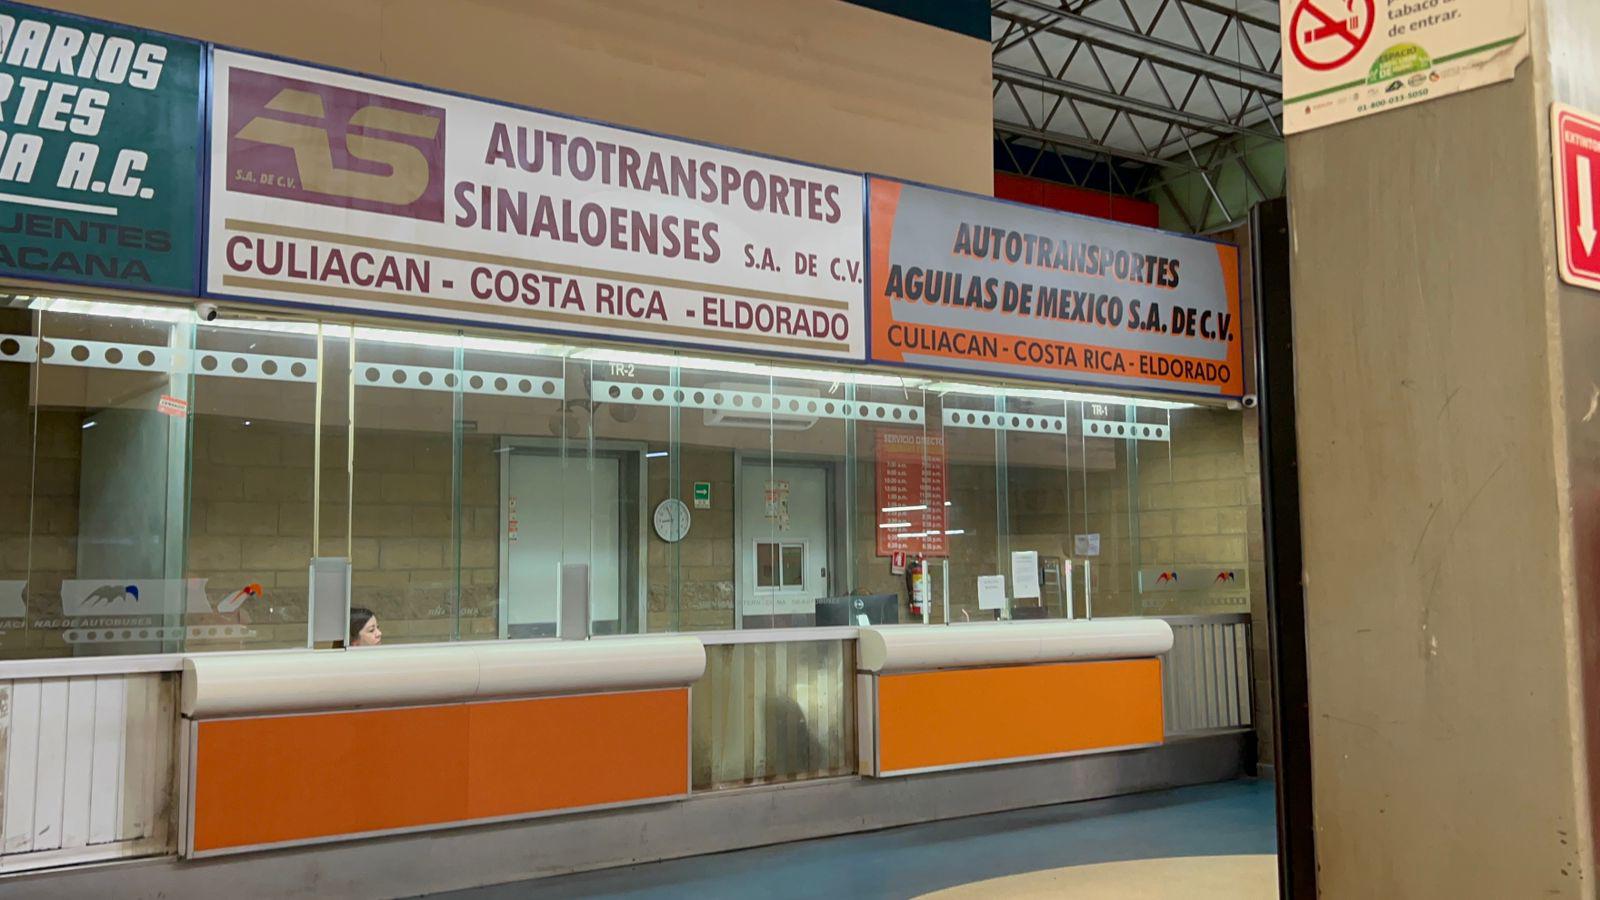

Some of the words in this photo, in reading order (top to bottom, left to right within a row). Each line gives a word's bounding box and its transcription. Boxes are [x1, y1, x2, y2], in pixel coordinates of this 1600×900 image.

[1387, 0, 1439, 20] tabaco
[1388, 24, 1406, 38] de
[1409, 9, 1462, 31] entrar.
[56, 141, 155, 199] A.C.
[235, 169, 256, 183] S.A.
[260, 173, 274, 185] DE
[277, 176, 296, 189] C.V.
[485, 121, 842, 224] AUTOTRANSPORTES
[454, 181, 721, 264] SINALOENSES
[744, 243, 781, 273] S.A.
[795, 252, 818, 278] DE
[830, 257, 863, 284] C.V.
[953, 222, 1180, 289] AUTOTRANSPORTES
[226, 236, 431, 294] CULIACAN
[470, 267, 586, 311] COSTA
[596, 282, 668, 321] RICA
[703, 296, 850, 342] ELDORADO
[884, 264, 998, 310] AGUILAS
[1001, 280, 1032, 316] DE
[1035, 286, 1124, 328] MEXICO
[1127, 302, 1168, 335] S.A.
[1171, 305, 1197, 337] DE
[1199, 309, 1235, 342] C.V.
[609, 361, 635, 377] TR-2
[887, 324, 998, 358] CULIACAN
[1014, 339, 1078, 367] COSTA
[1084, 348, 1126, 372] RICA
[1139, 354, 1231, 384] ELDORADO
[1091, 403, 1108, 416] TR-1
[884, 434, 914, 445] SERVICIO
